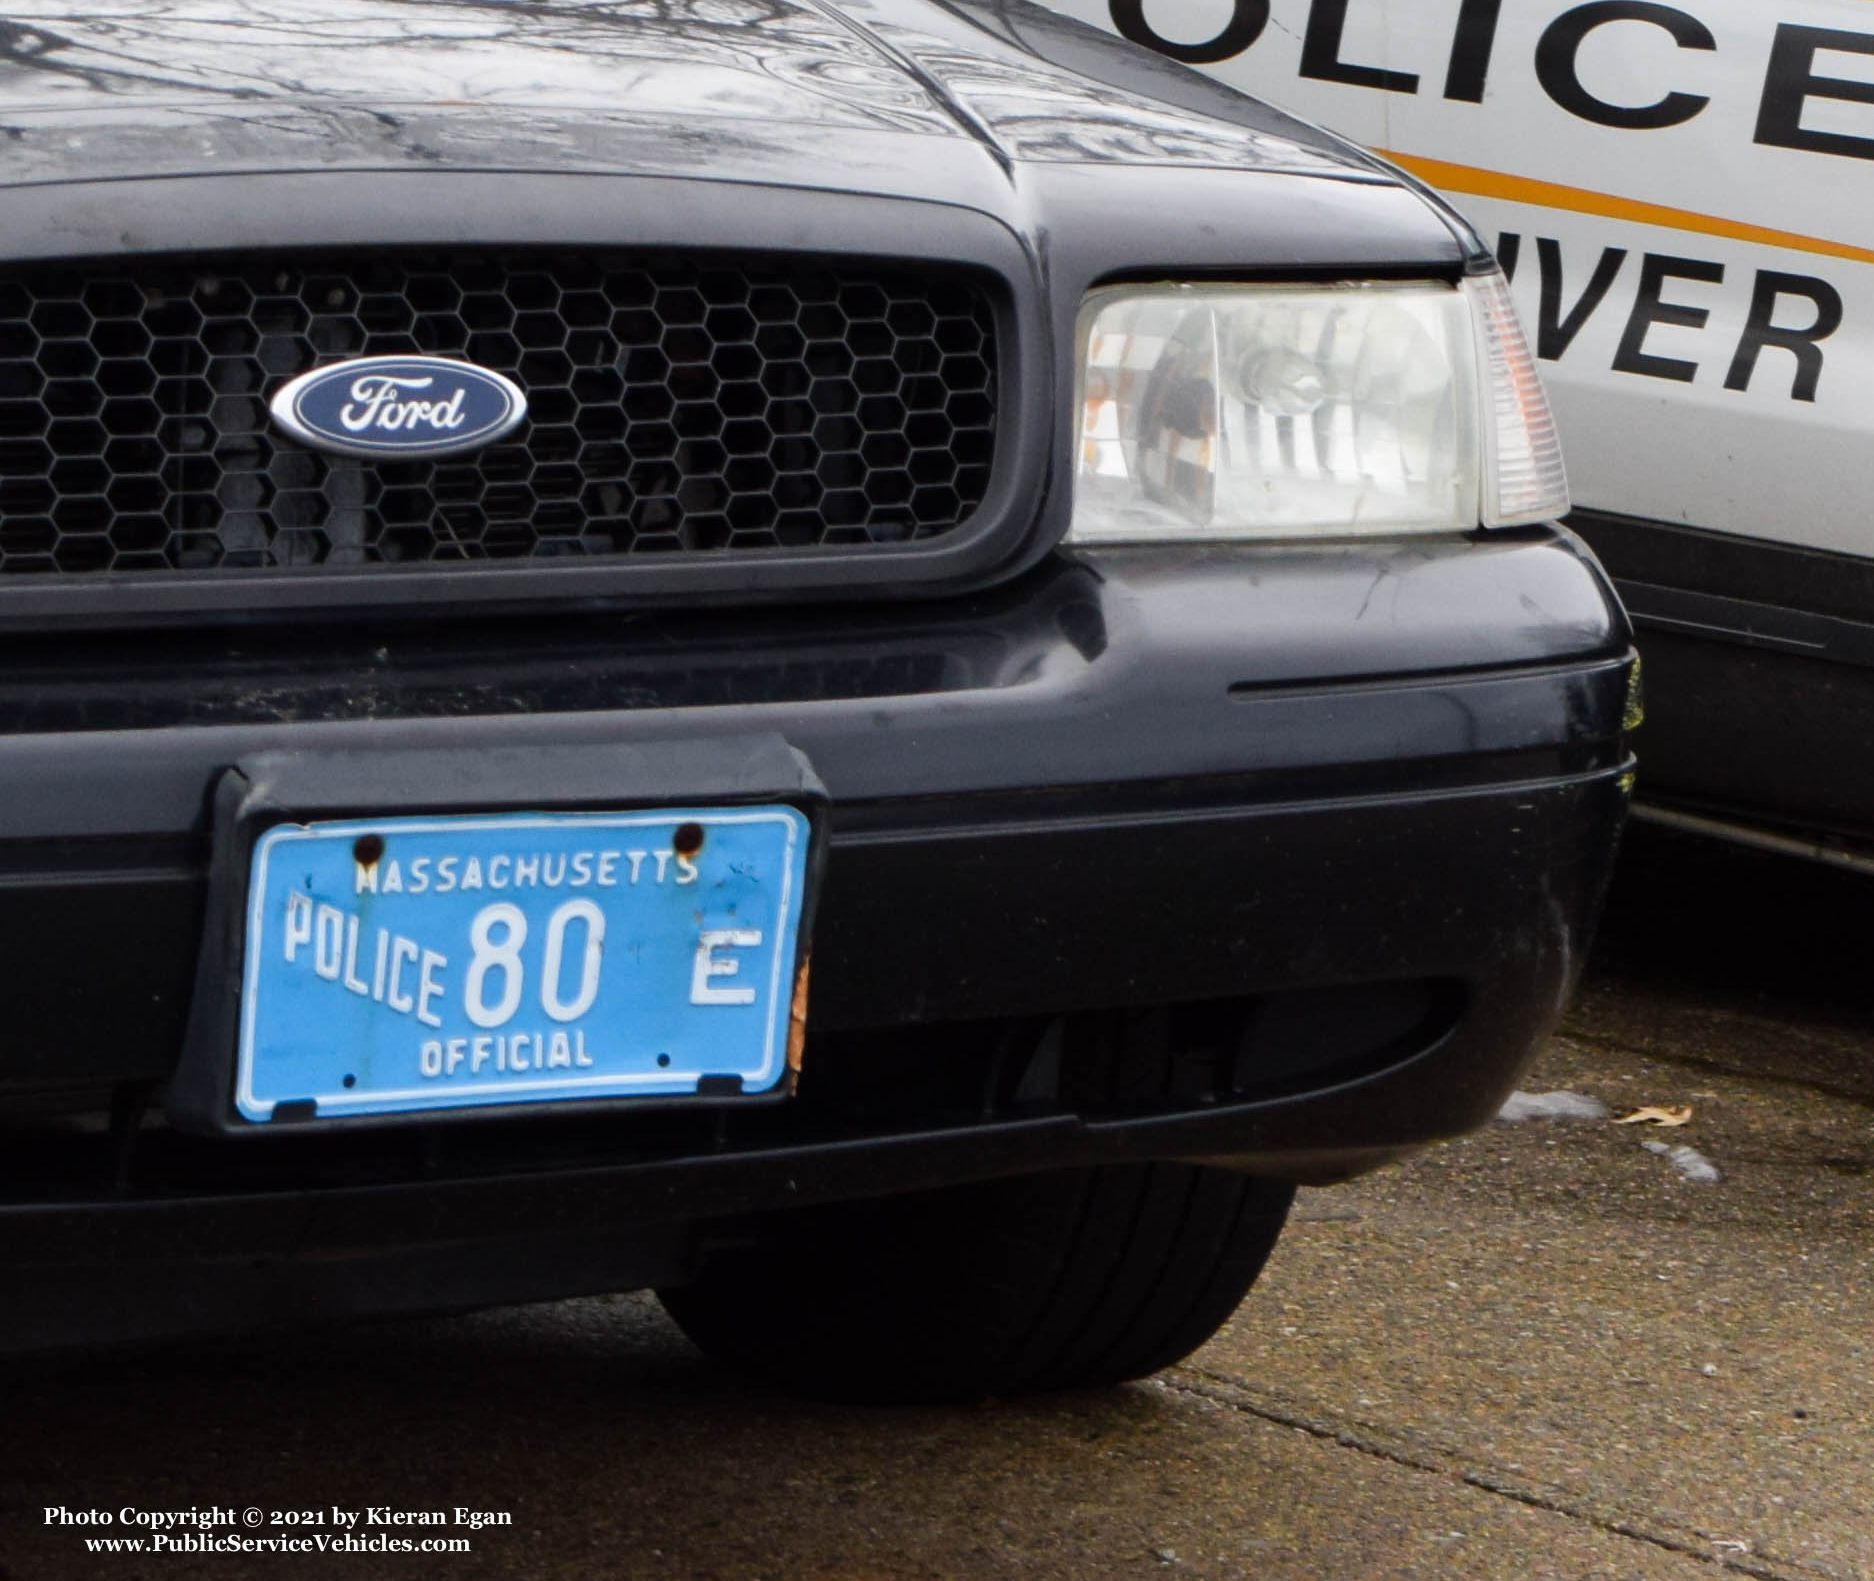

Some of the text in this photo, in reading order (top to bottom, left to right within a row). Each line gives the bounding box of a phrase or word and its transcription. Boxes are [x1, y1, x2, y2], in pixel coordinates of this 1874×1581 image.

[340, 375, 466, 431] Ford
[354, 849, 700, 895] MASSACHUSETTS
[283, 890, 763, 1028] POLICE 80 E
[419, 1030, 595, 1078] OFFICIAL
